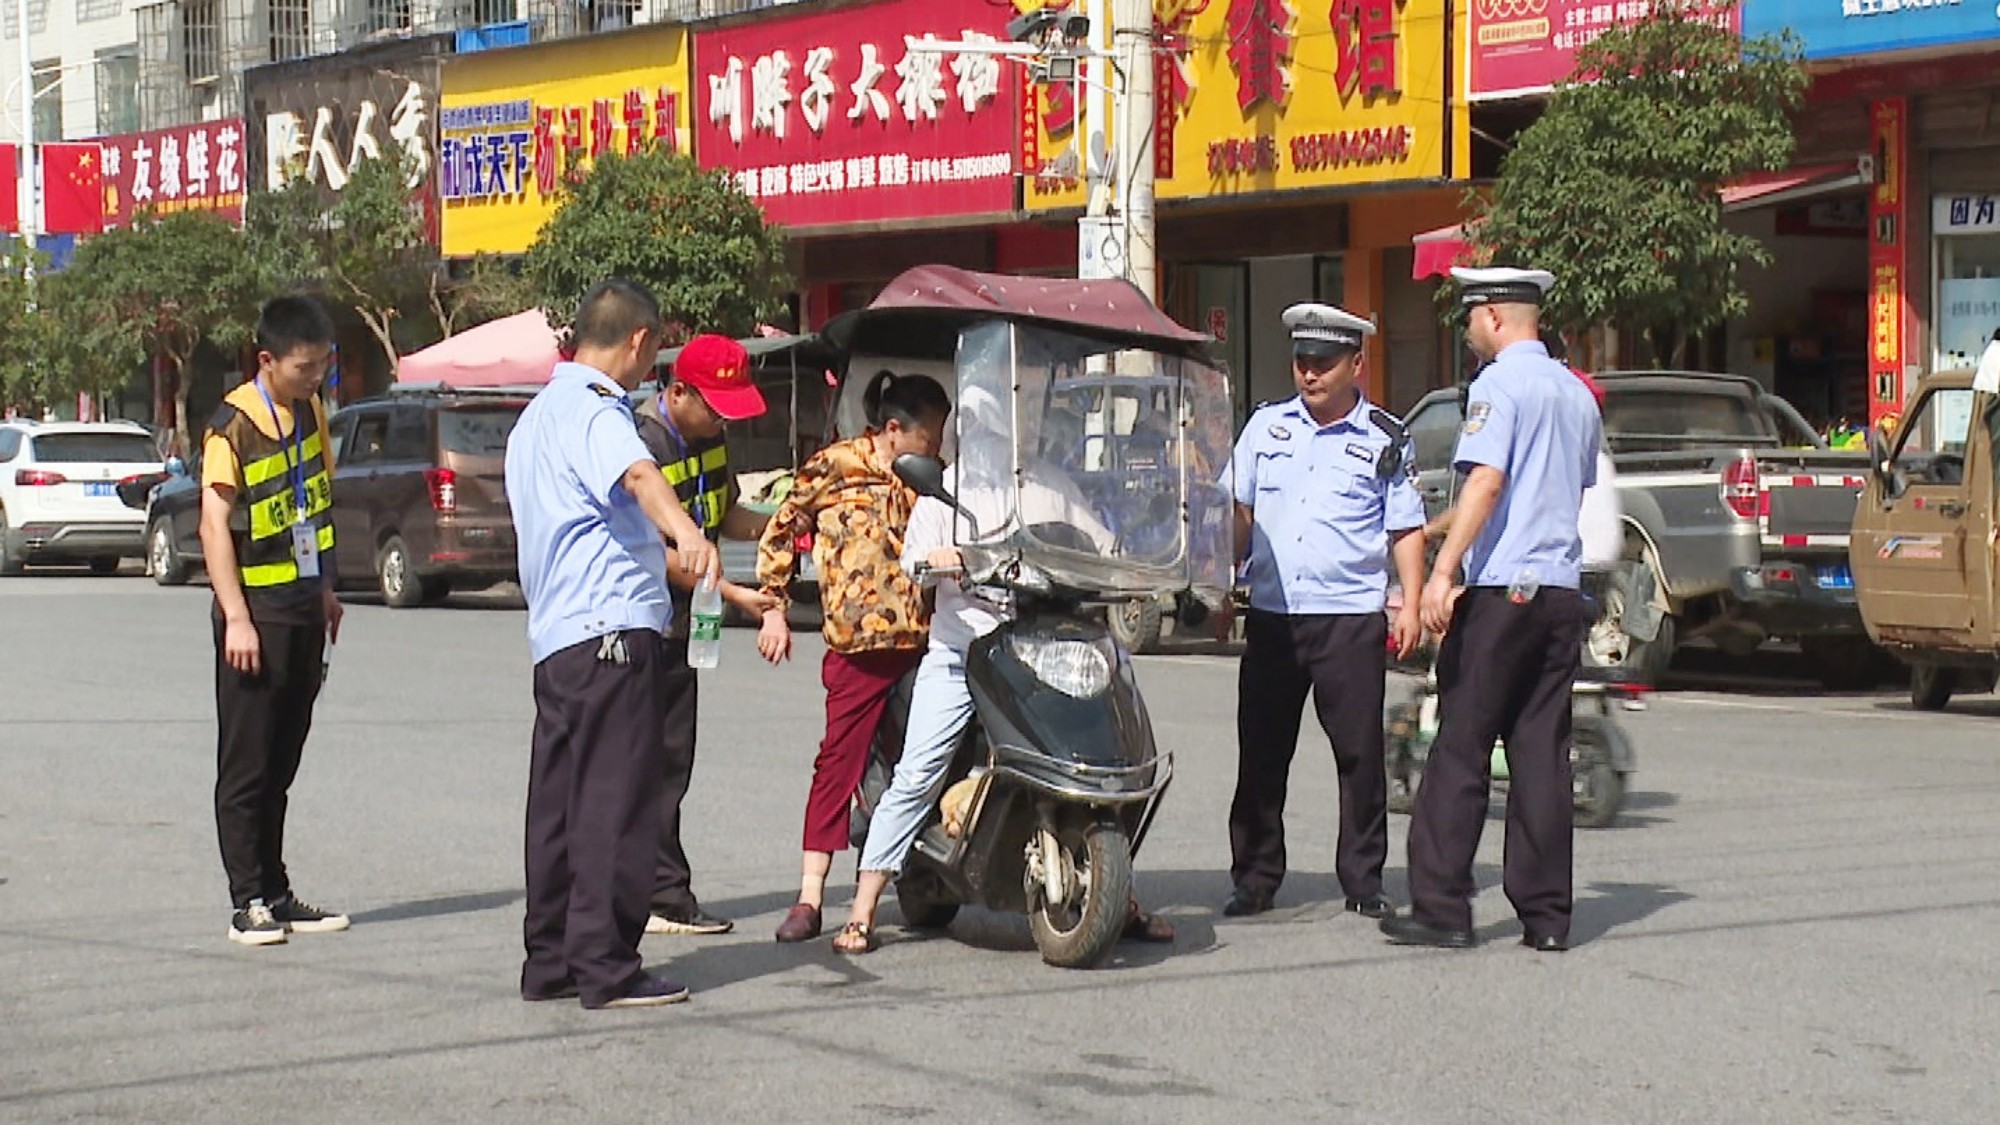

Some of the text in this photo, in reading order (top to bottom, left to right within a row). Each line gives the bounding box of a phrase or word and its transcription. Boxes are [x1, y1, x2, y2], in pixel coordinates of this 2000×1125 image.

[131, 125, 239, 201] 友缘鲜花
[443, 133, 527, 196] 和成天下
[761, 166, 787, 196] 夜宵
[790, 160, 844, 194] 特色火锅
[879, 152, 908, 185] 烧烤
